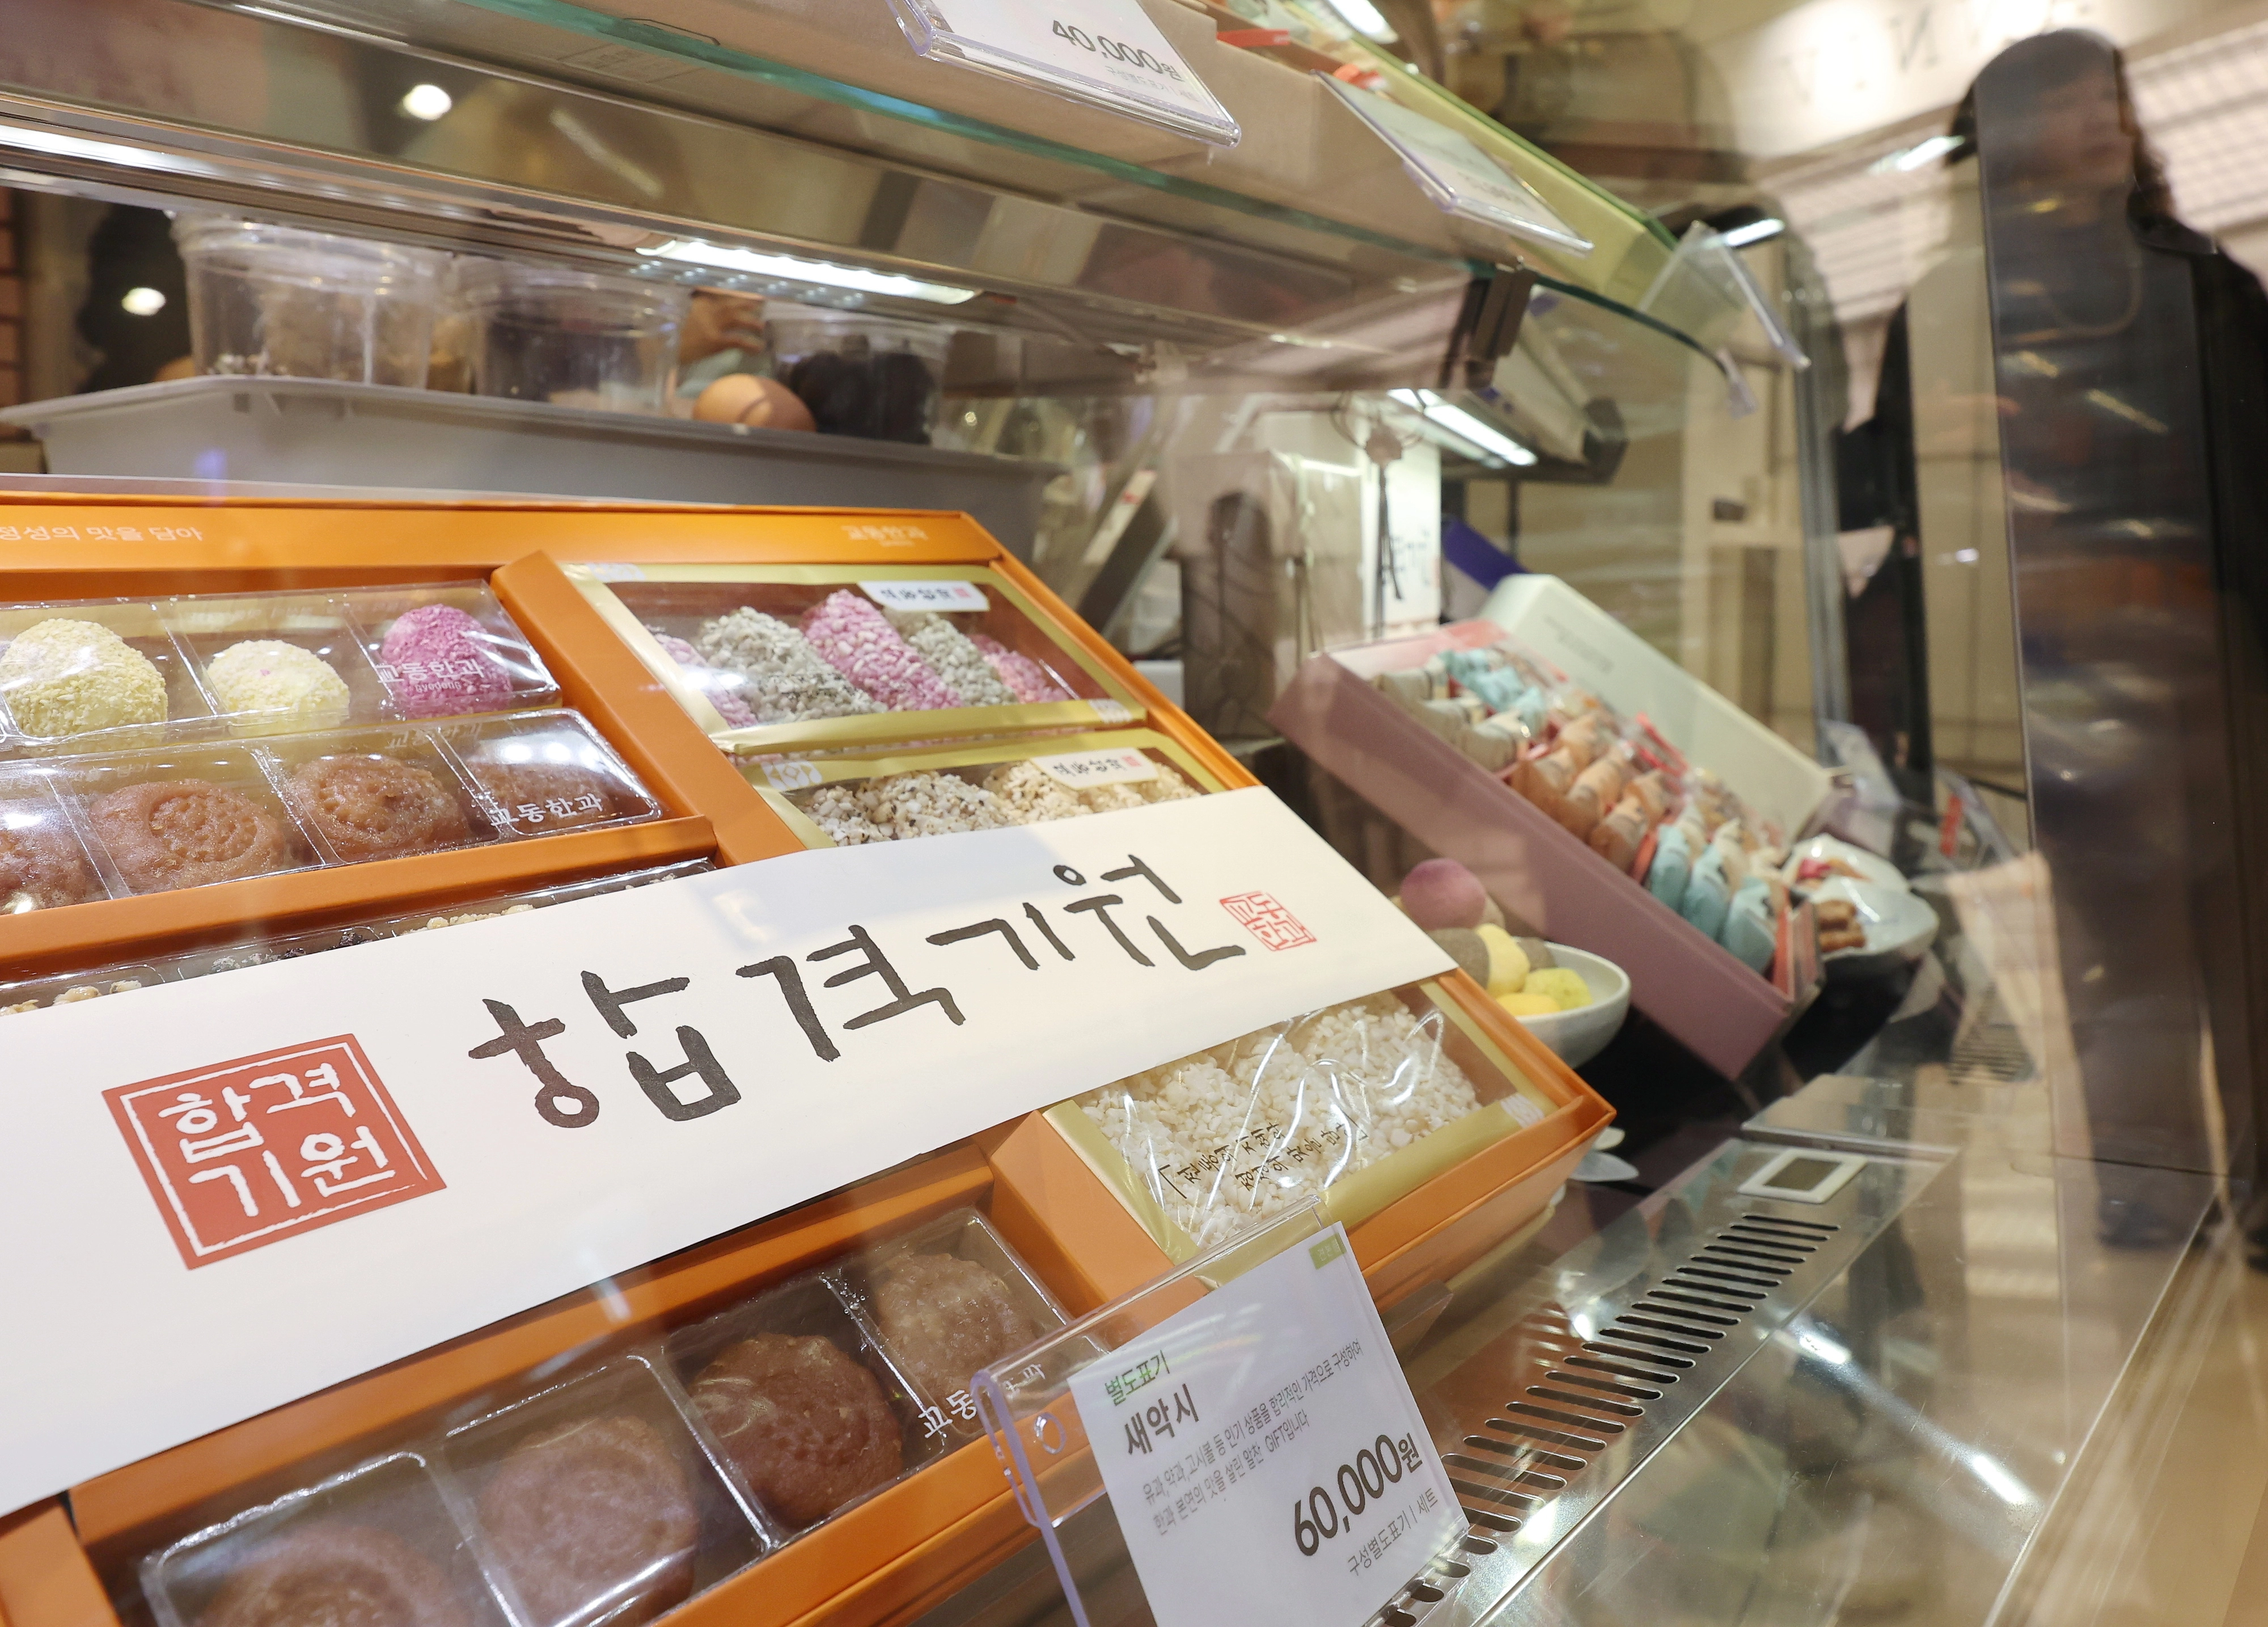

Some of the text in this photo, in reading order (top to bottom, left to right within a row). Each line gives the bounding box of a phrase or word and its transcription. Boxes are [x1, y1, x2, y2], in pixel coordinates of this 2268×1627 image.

[1052, 19, 1185, 82] 40,000원
[86, 526, 143, 541] 맛을
[147, 526, 203, 541] 담아
[375, 658, 485, 683] 교동한과
[490, 793, 603, 827] 교동한과
[158, 1062, 356, 1164] 합격
[188, 1125, 396, 1217] 기원
[1287, 1138, 1322, 1164] 맛을
[1105, 1349, 1170, 1406] 별도표기
[1213, 1434, 1226, 1456] 등
[1224, 1420, 1245, 1448] 인기
[1244, 1403, 1272, 1435] 상품을
[1268, 1379, 1304, 1417] 합리적인
[1302, 1359, 1334, 1391] 가격으로
[1332, 1338, 1364, 1371] 구성하여
[1124, 1383, 1199, 1455] 새악시
[1153, 1409, 1310, 1535] 한과 본연의 맛을 살린 알찬 GIFT입니다
[1294, 1432, 1423, 1556] 60,000원
[1348, 1510, 1411, 1576] 구성별도표기
[1416, 1488, 1438, 1514] 세트
